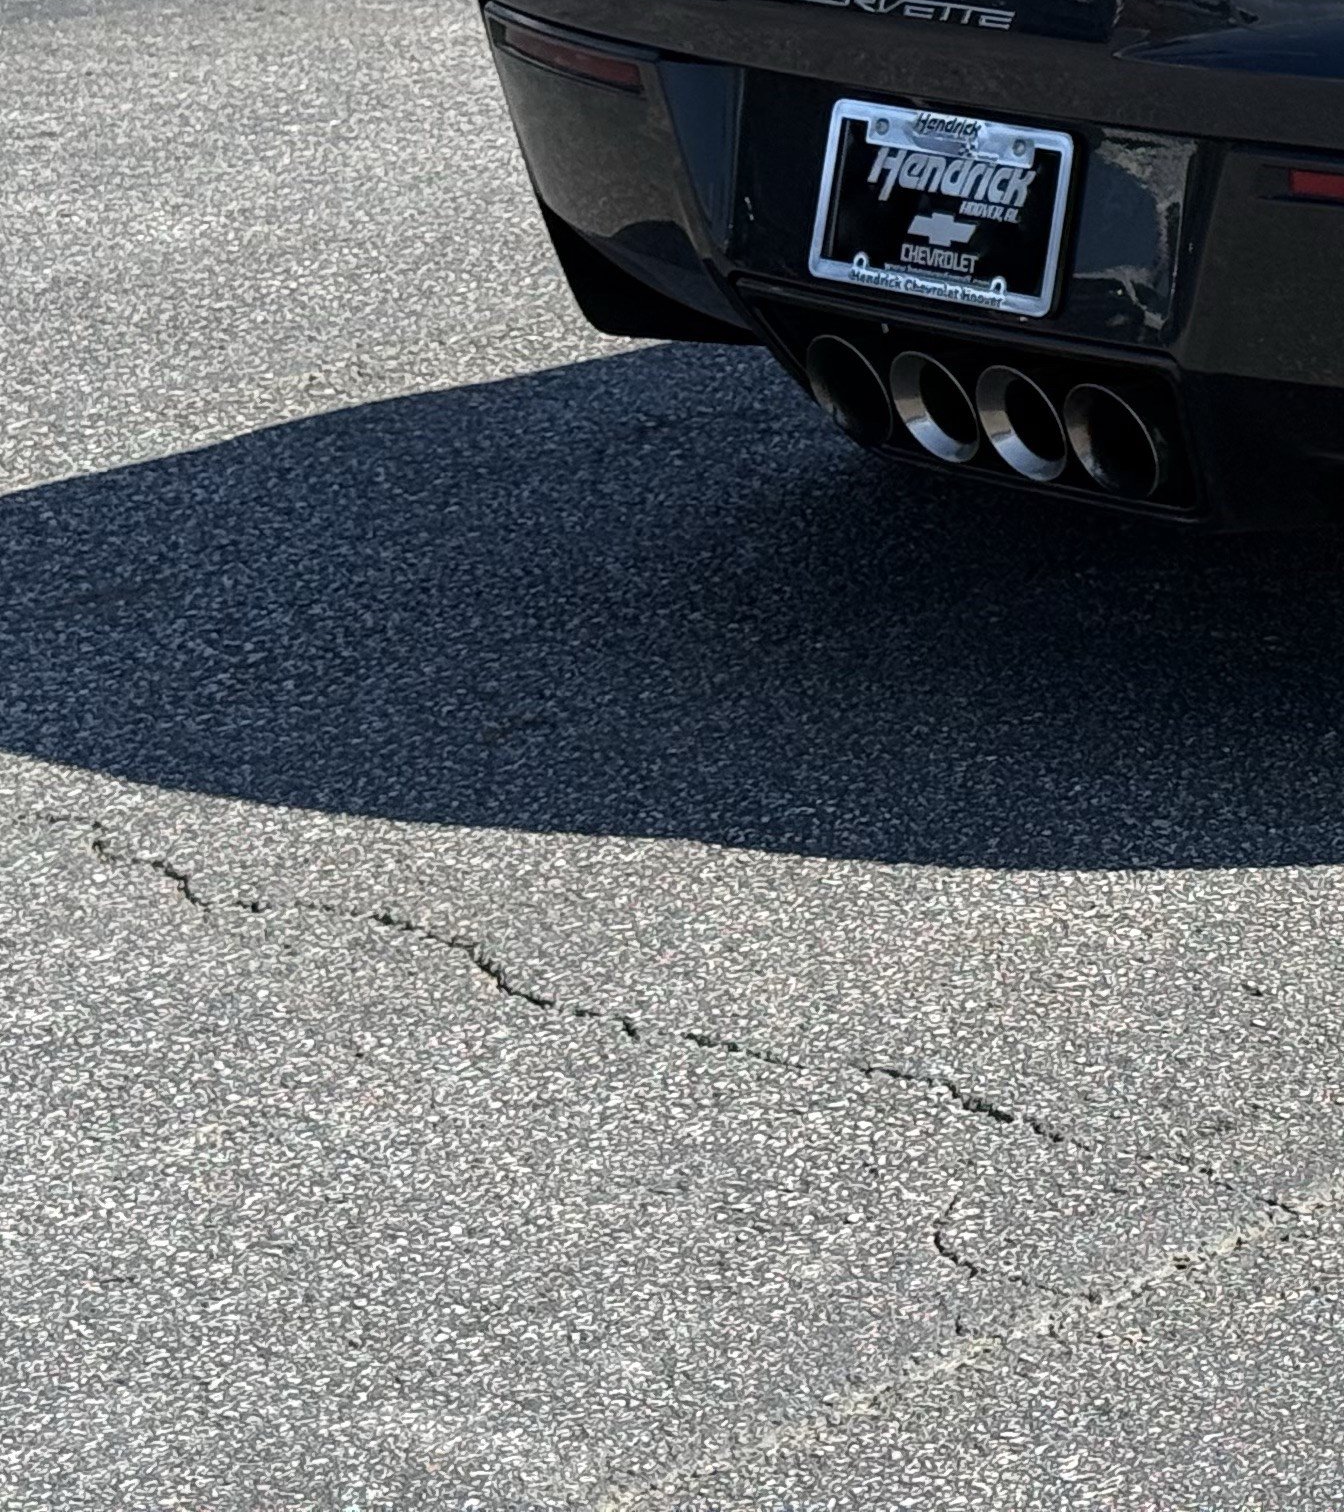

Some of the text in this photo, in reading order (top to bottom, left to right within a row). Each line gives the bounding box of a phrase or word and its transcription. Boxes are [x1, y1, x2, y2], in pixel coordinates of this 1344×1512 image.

[912, 111, 983, 140] Hendrick
[867, 146, 1037, 208] Hendrick
[900, 243, 979, 274] CHEVROLET
[849, 267, 901, 289] Hendrick
[904, 278, 960, 301] Chevrolet
